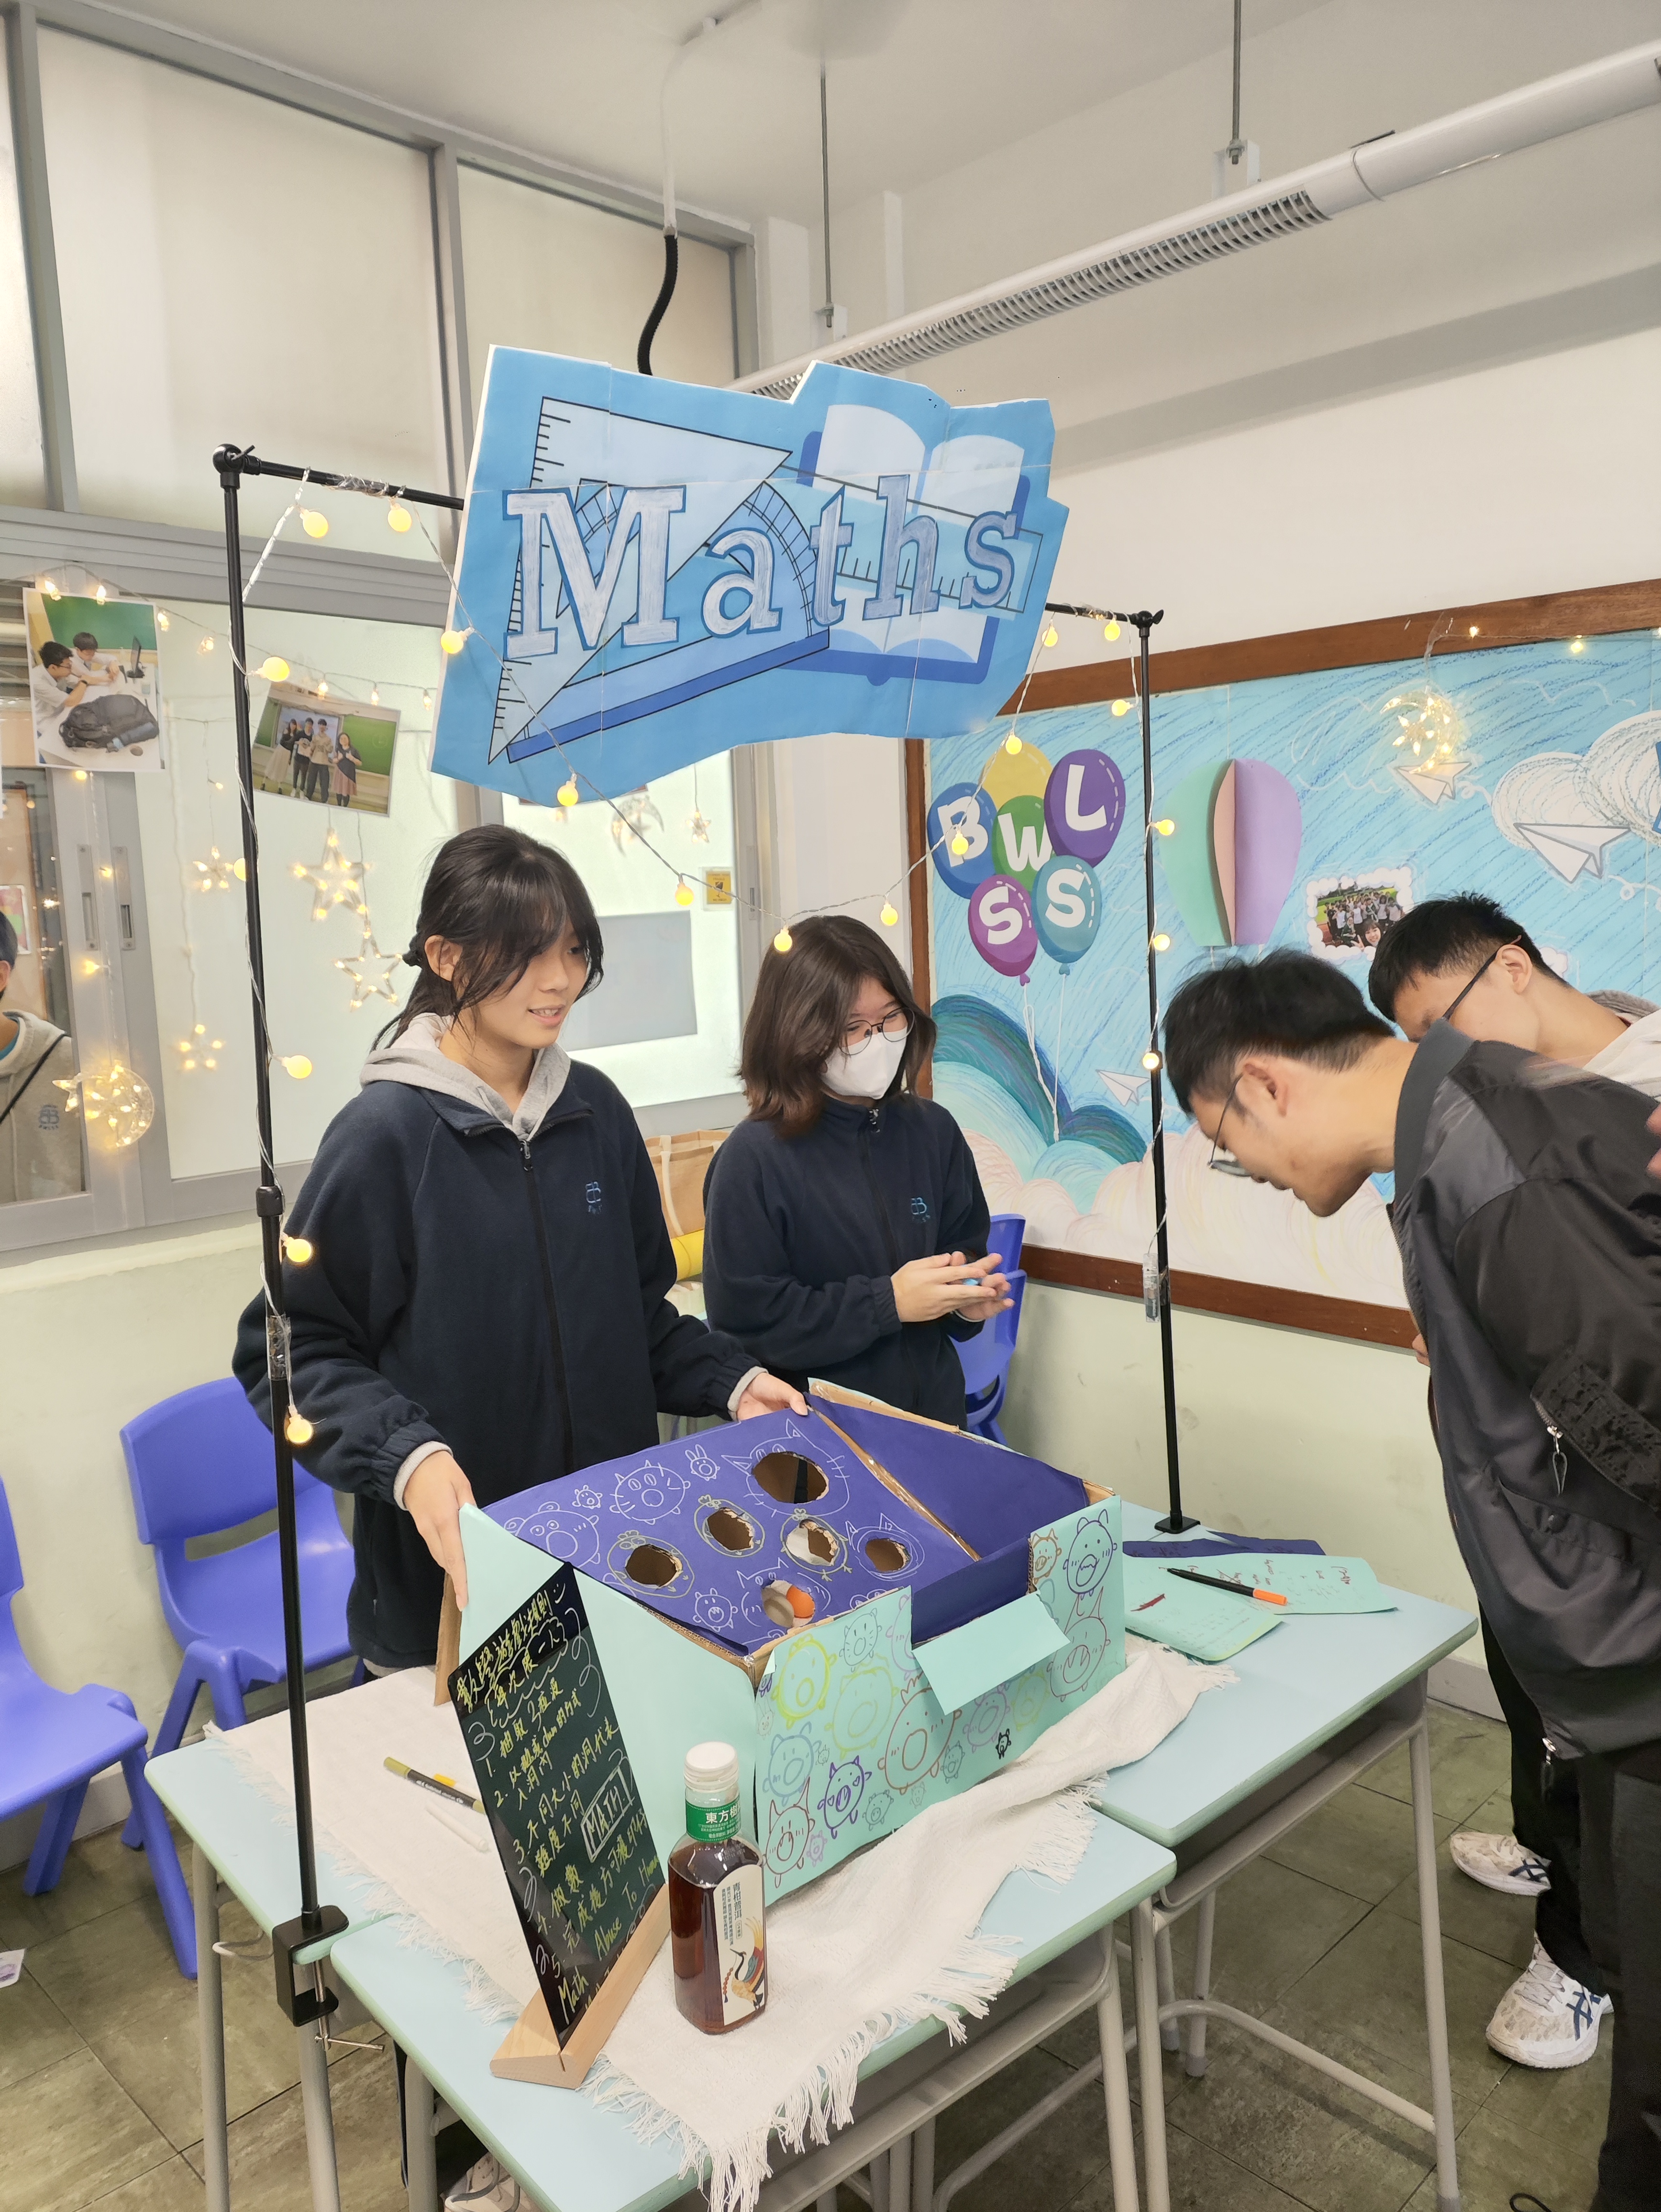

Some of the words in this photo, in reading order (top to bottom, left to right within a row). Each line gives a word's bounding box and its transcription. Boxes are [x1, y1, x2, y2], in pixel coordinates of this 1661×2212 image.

[502, 475, 1019, 659] Maths
[705, 1802, 741, 1824] 東方樹
[557, 1966, 588, 2024] Math
[594, 1917, 621, 1961] Abuse
[621, 1881, 637, 1910] To
